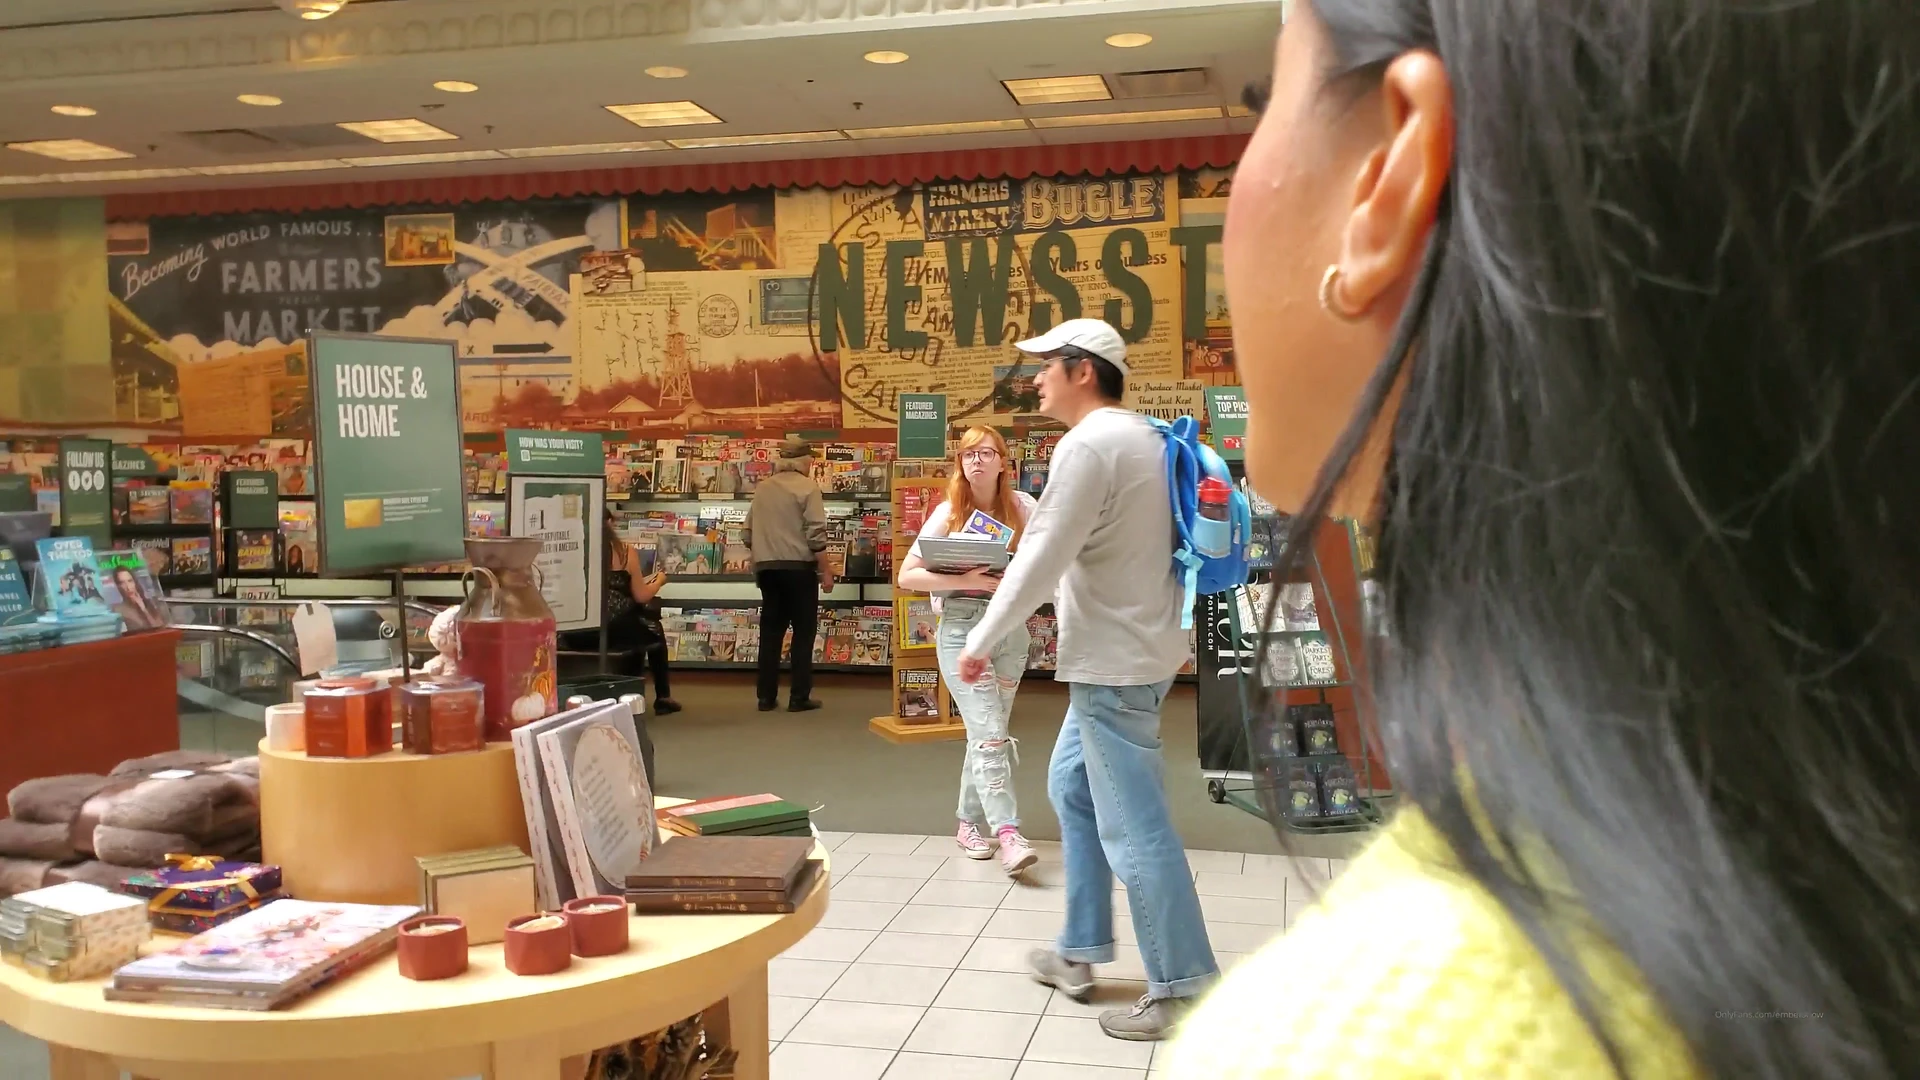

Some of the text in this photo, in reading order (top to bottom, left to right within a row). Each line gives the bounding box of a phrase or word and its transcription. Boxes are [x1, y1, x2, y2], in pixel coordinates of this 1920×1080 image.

[930, 183, 1010, 208] FARMERS
[1022, 178, 1157, 230] BUGLE
[122, 242, 208, 301] Becoming
[211, 224, 271, 251] WORLD
[221, 257, 382, 295] FARMERS
[223, 307, 382, 345] MARKET
[336, 363, 428, 399] HOUSE &
[1129, 381, 1202, 394] The Produce Market
[905, 402, 934, 411] FEATURED
[1138, 395, 1192, 407] That Just Kept
[1215, 401, 1232, 413] TOP
[338, 403, 401, 438] HOME
[905, 411, 938, 420] MAGAZINES
[519, 437, 534, 448] HOW
[534, 437, 548, 449] WAS
[548, 438, 565, 449] YOUR
[67, 451, 105, 468] FOLLOW US
[54, 539, 83, 550] OVER
[1310, 666, 1334, 675] FOREST
